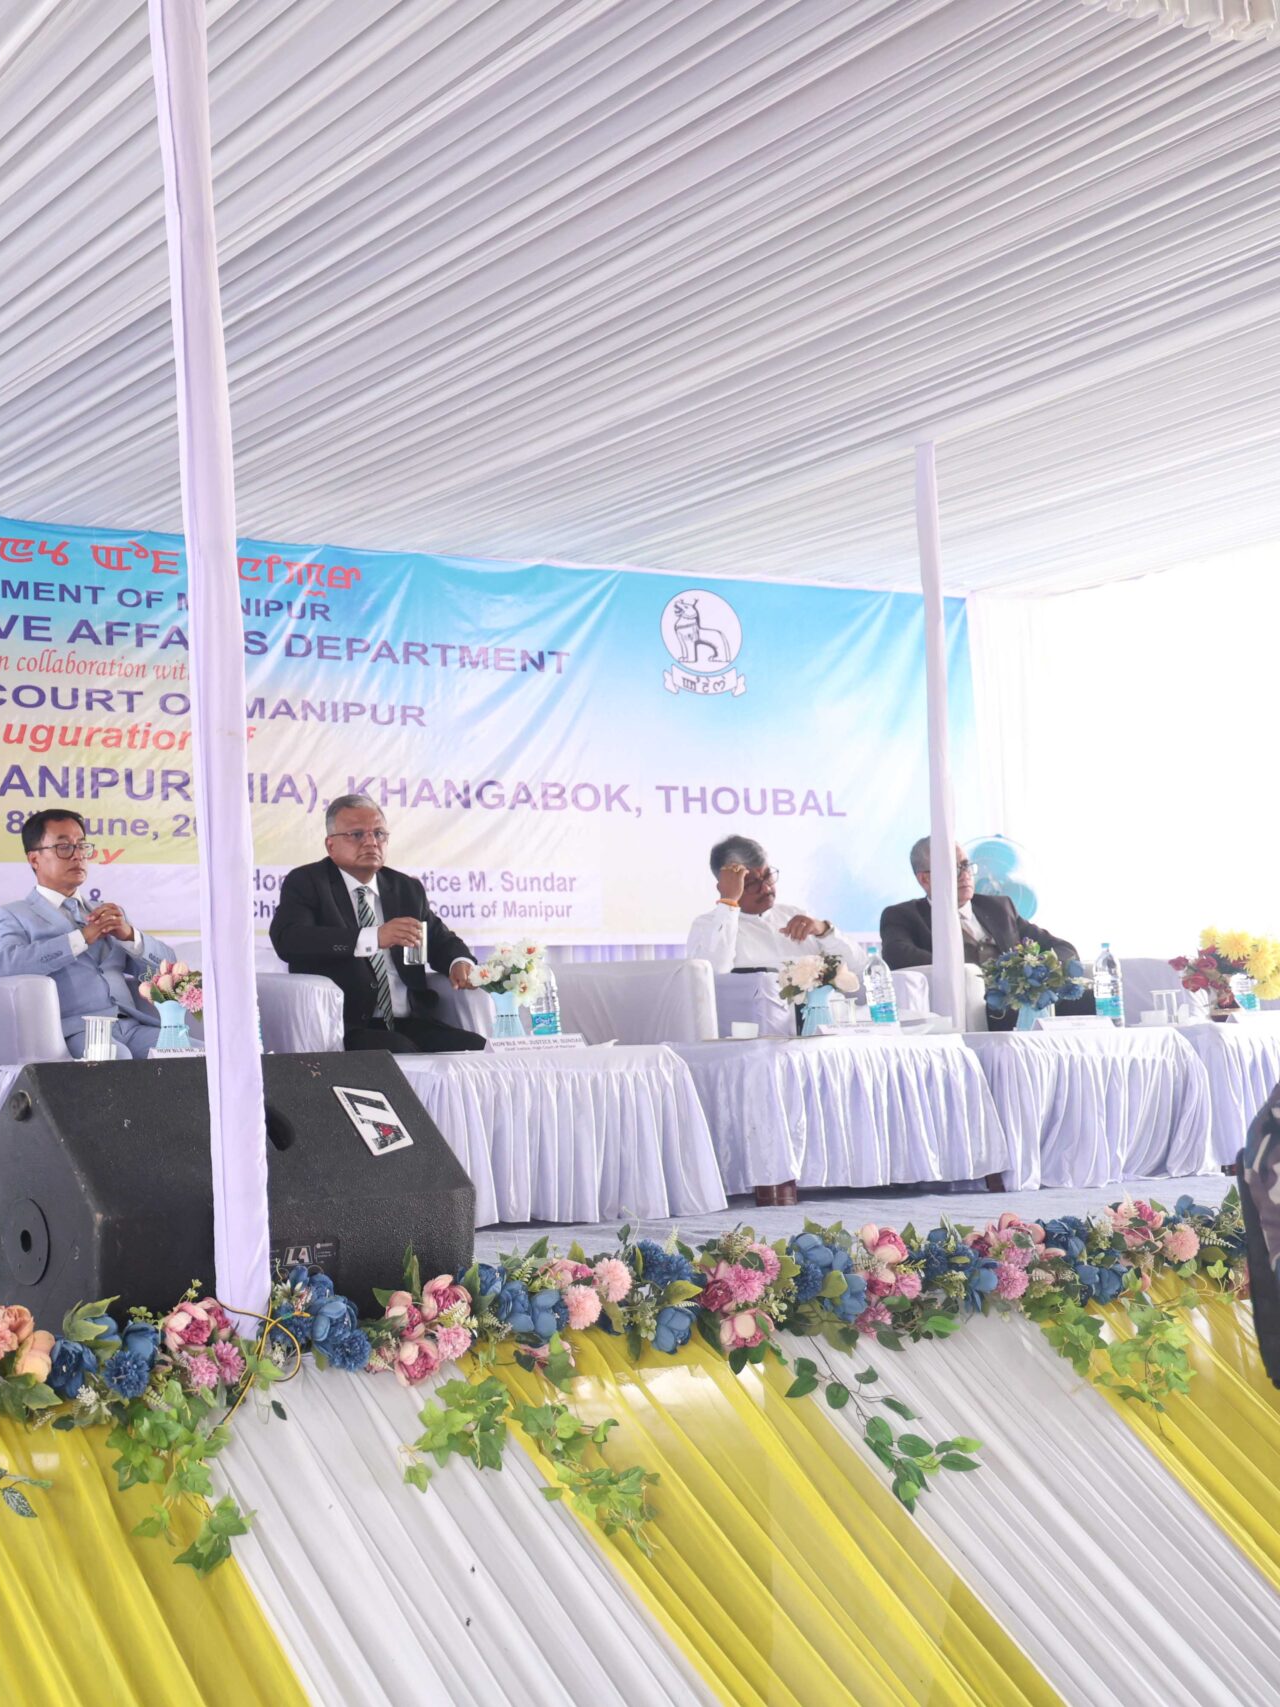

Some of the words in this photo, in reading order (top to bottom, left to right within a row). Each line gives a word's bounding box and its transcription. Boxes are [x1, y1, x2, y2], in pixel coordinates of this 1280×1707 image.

[117, 588, 164, 609] OF
[67, 619, 269, 656] AFFAS
[284, 633, 570, 674] DEPARTMENT
[16, 649, 146, 678] collaboration
[153, 659, 189, 680] wit
[346, 775, 643, 817] KHANGABOK,
[655, 785, 848, 817] THOUBAL
[83, 817, 160, 841] une,
[421, 871, 462, 893] tice
[468, 871, 494, 892] M.
[500, 870, 577, 893] Sundar
[480, 900, 498, 918] of
[503, 901, 573, 921] Manipur
